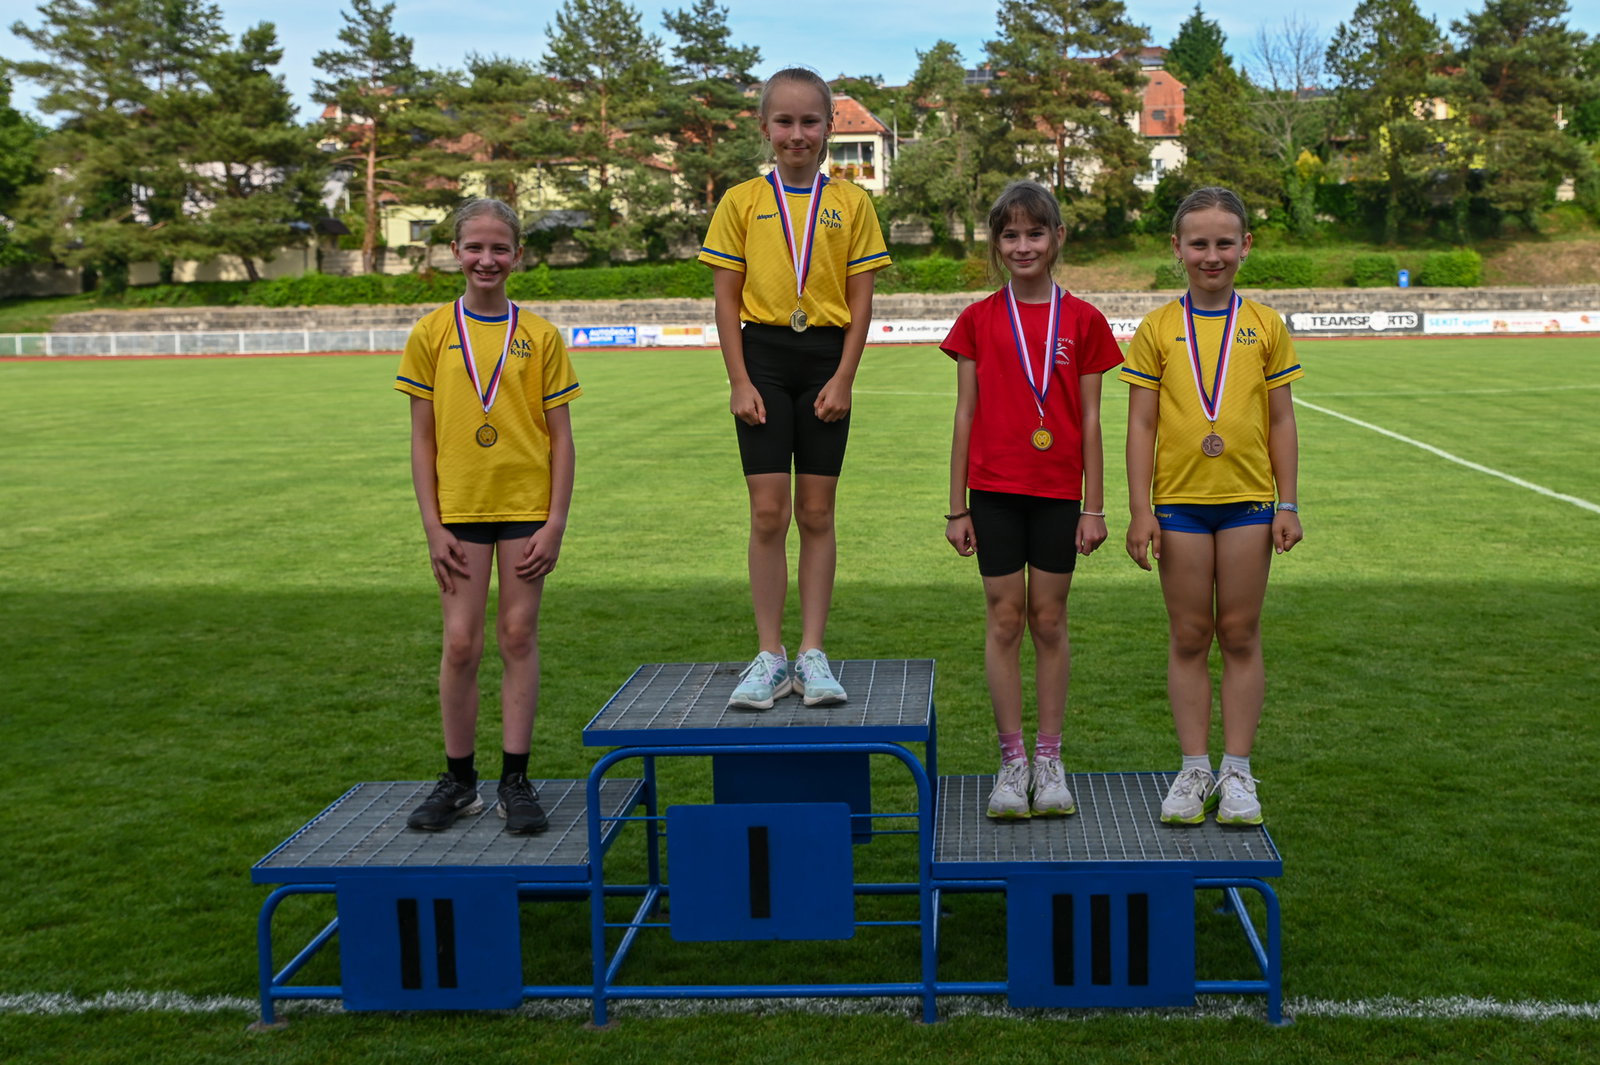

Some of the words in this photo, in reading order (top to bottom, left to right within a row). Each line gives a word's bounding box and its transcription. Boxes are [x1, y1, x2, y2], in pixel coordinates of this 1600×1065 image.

[821, 208, 842, 221] AK
[1109, 322, 1137, 332] TYS
[1311, 315, 1415, 327] TEAMSPRTS
[1236, 328, 1257, 337] AK
[511, 338, 532, 350] AK
